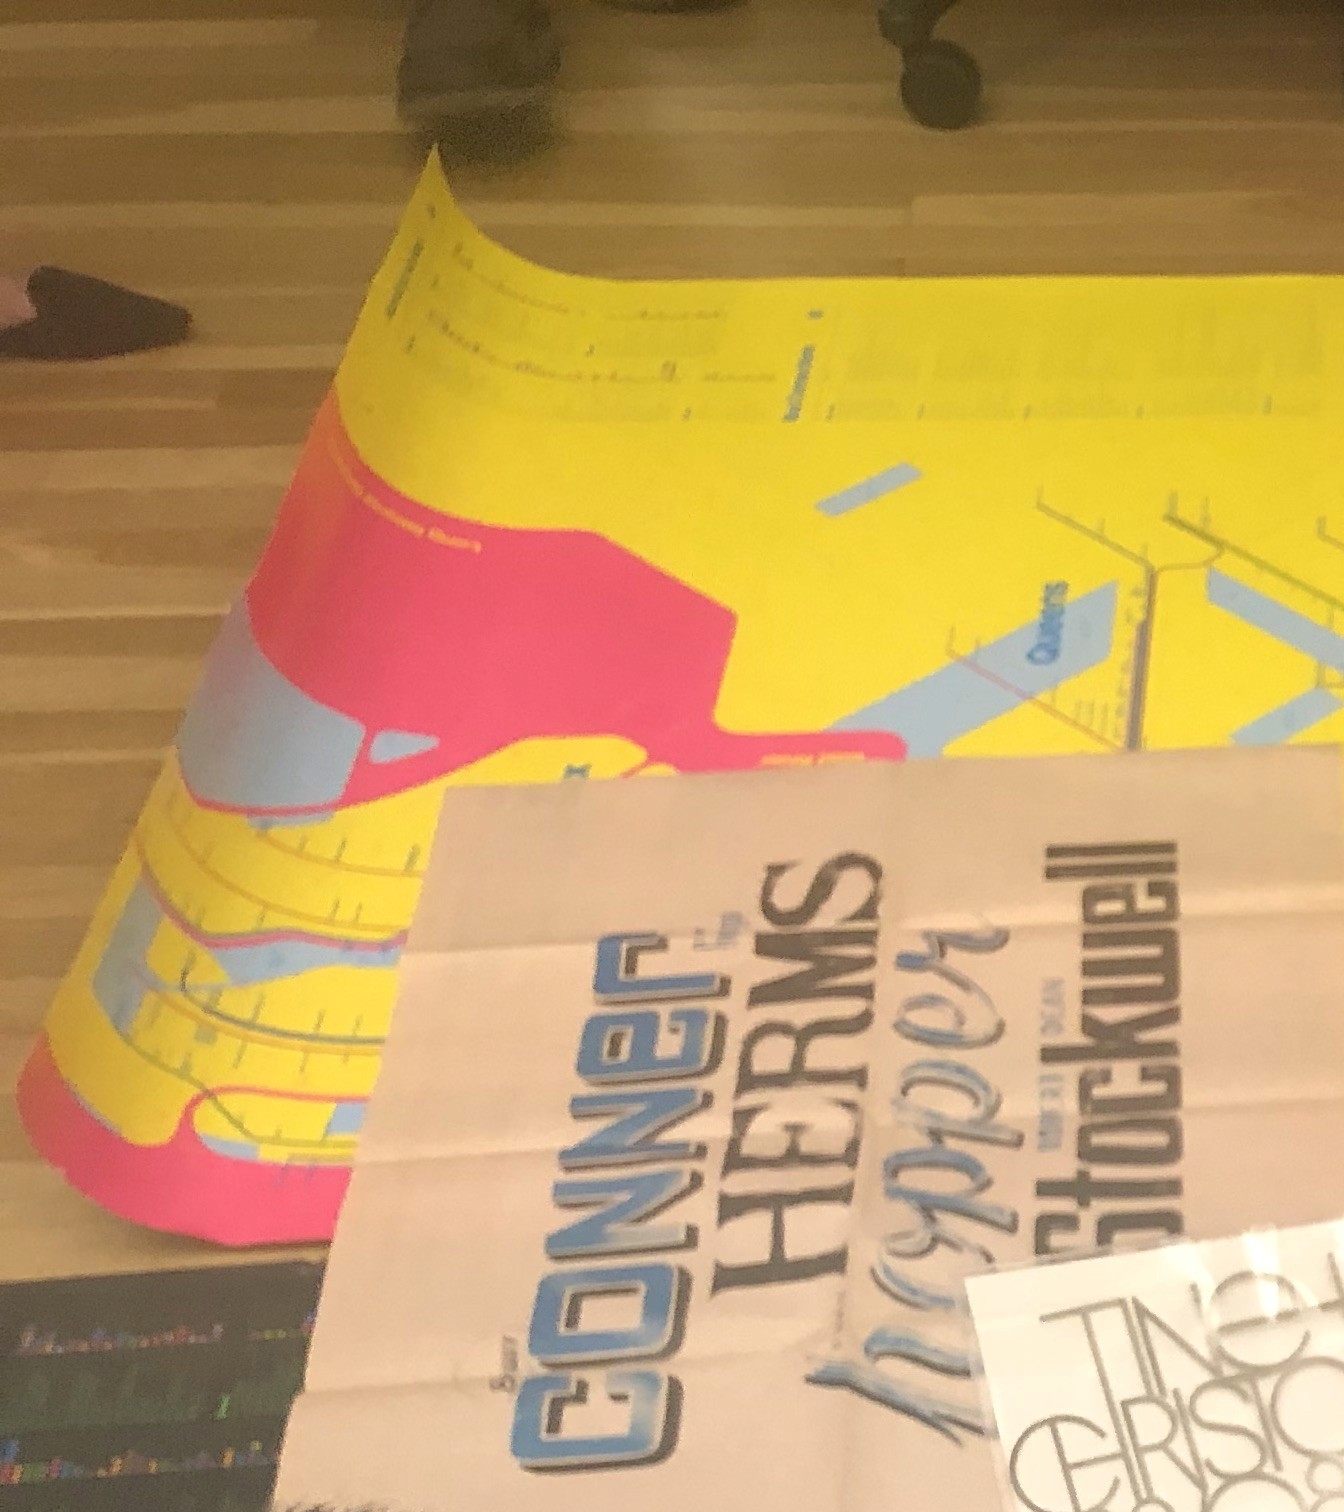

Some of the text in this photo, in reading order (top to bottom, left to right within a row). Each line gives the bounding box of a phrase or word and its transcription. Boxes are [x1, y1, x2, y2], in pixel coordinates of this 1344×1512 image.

[1024, 580, 1070, 667] Queens
[711, 849, 884, 1299] HERMS
[1033, 841, 1184, 1256] Stockwell
